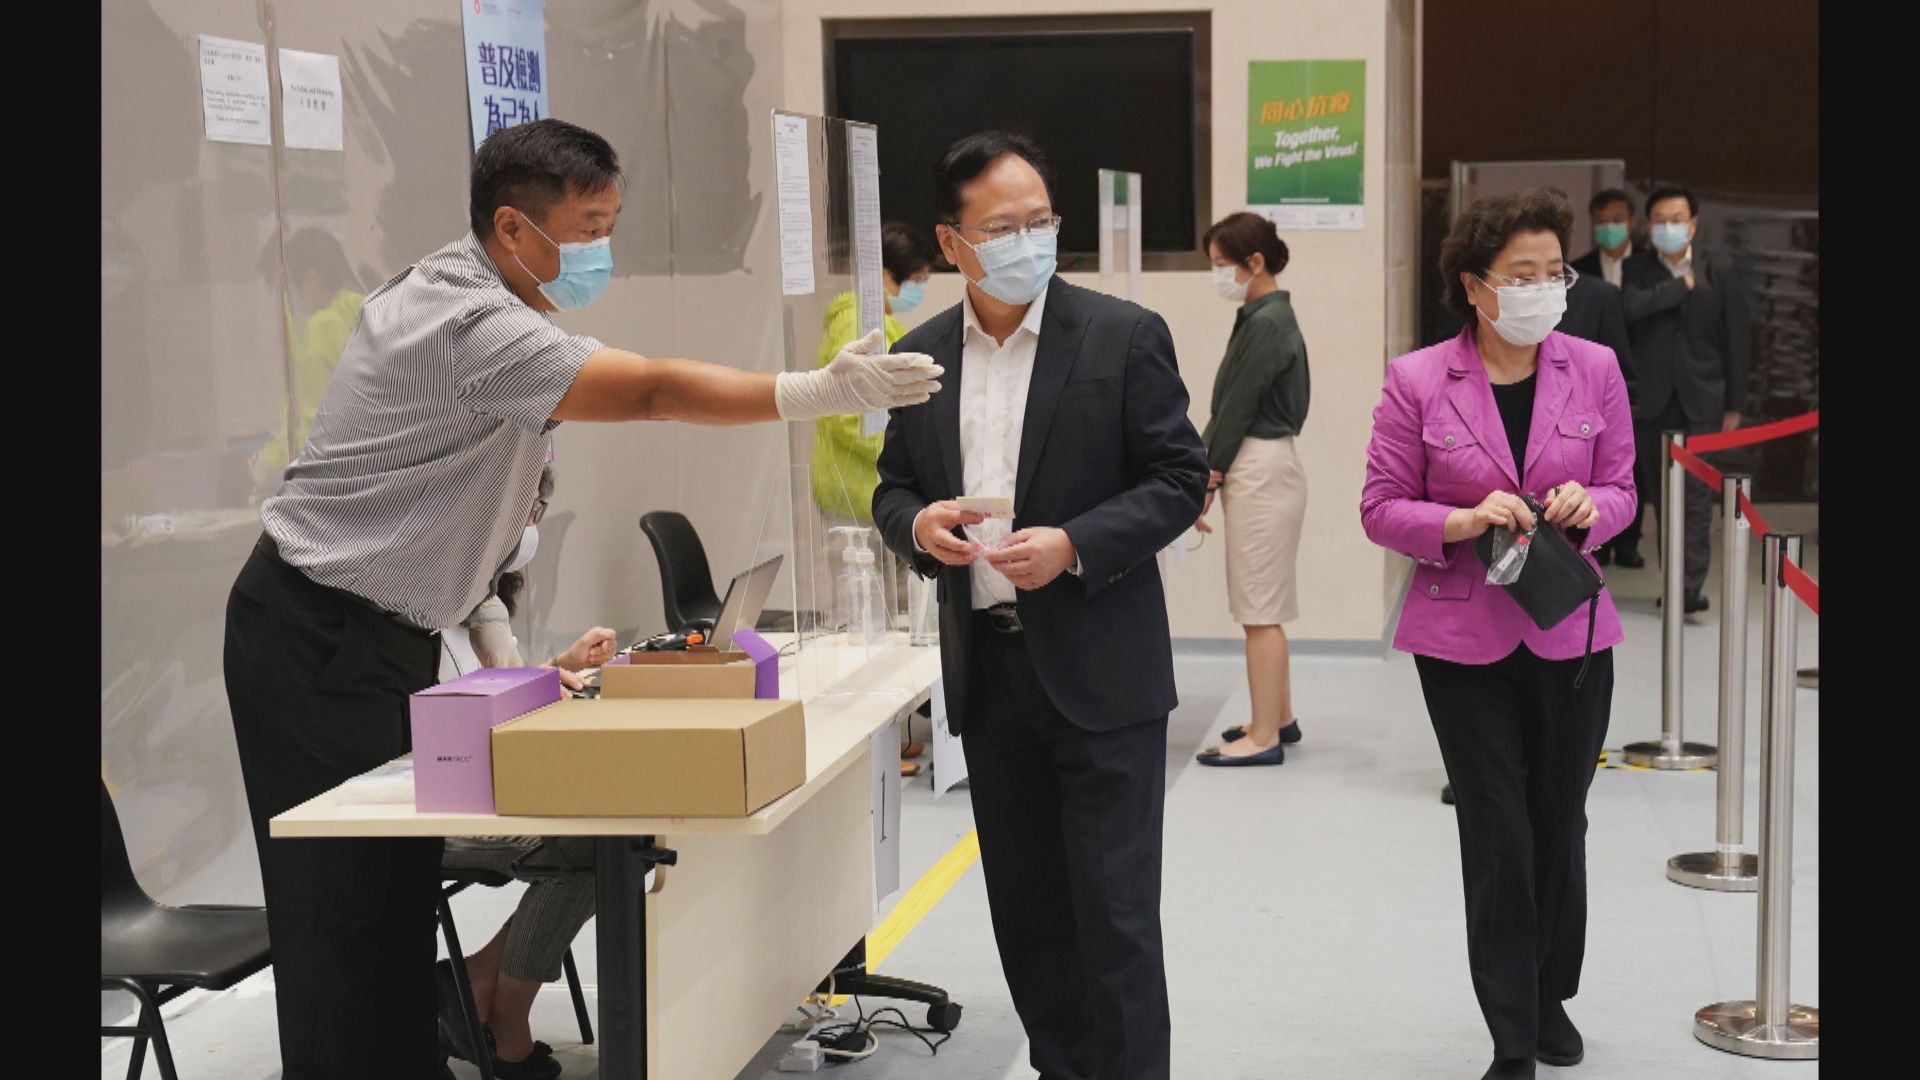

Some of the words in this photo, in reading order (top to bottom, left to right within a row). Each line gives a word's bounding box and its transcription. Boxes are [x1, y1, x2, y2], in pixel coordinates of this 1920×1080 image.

[478, 41, 541, 93] 普及檢測
[1260, 90, 1352, 126] 同心抗疫
[1254, 155, 1273, 169] We
[1274, 150, 1303, 168] Fight
[1303, 148, 1323, 162] the
[1324, 141, 1359, 159] Virus!
[1275, 126, 1340, 149] Together,
[880, 769, 887, 843] 1
